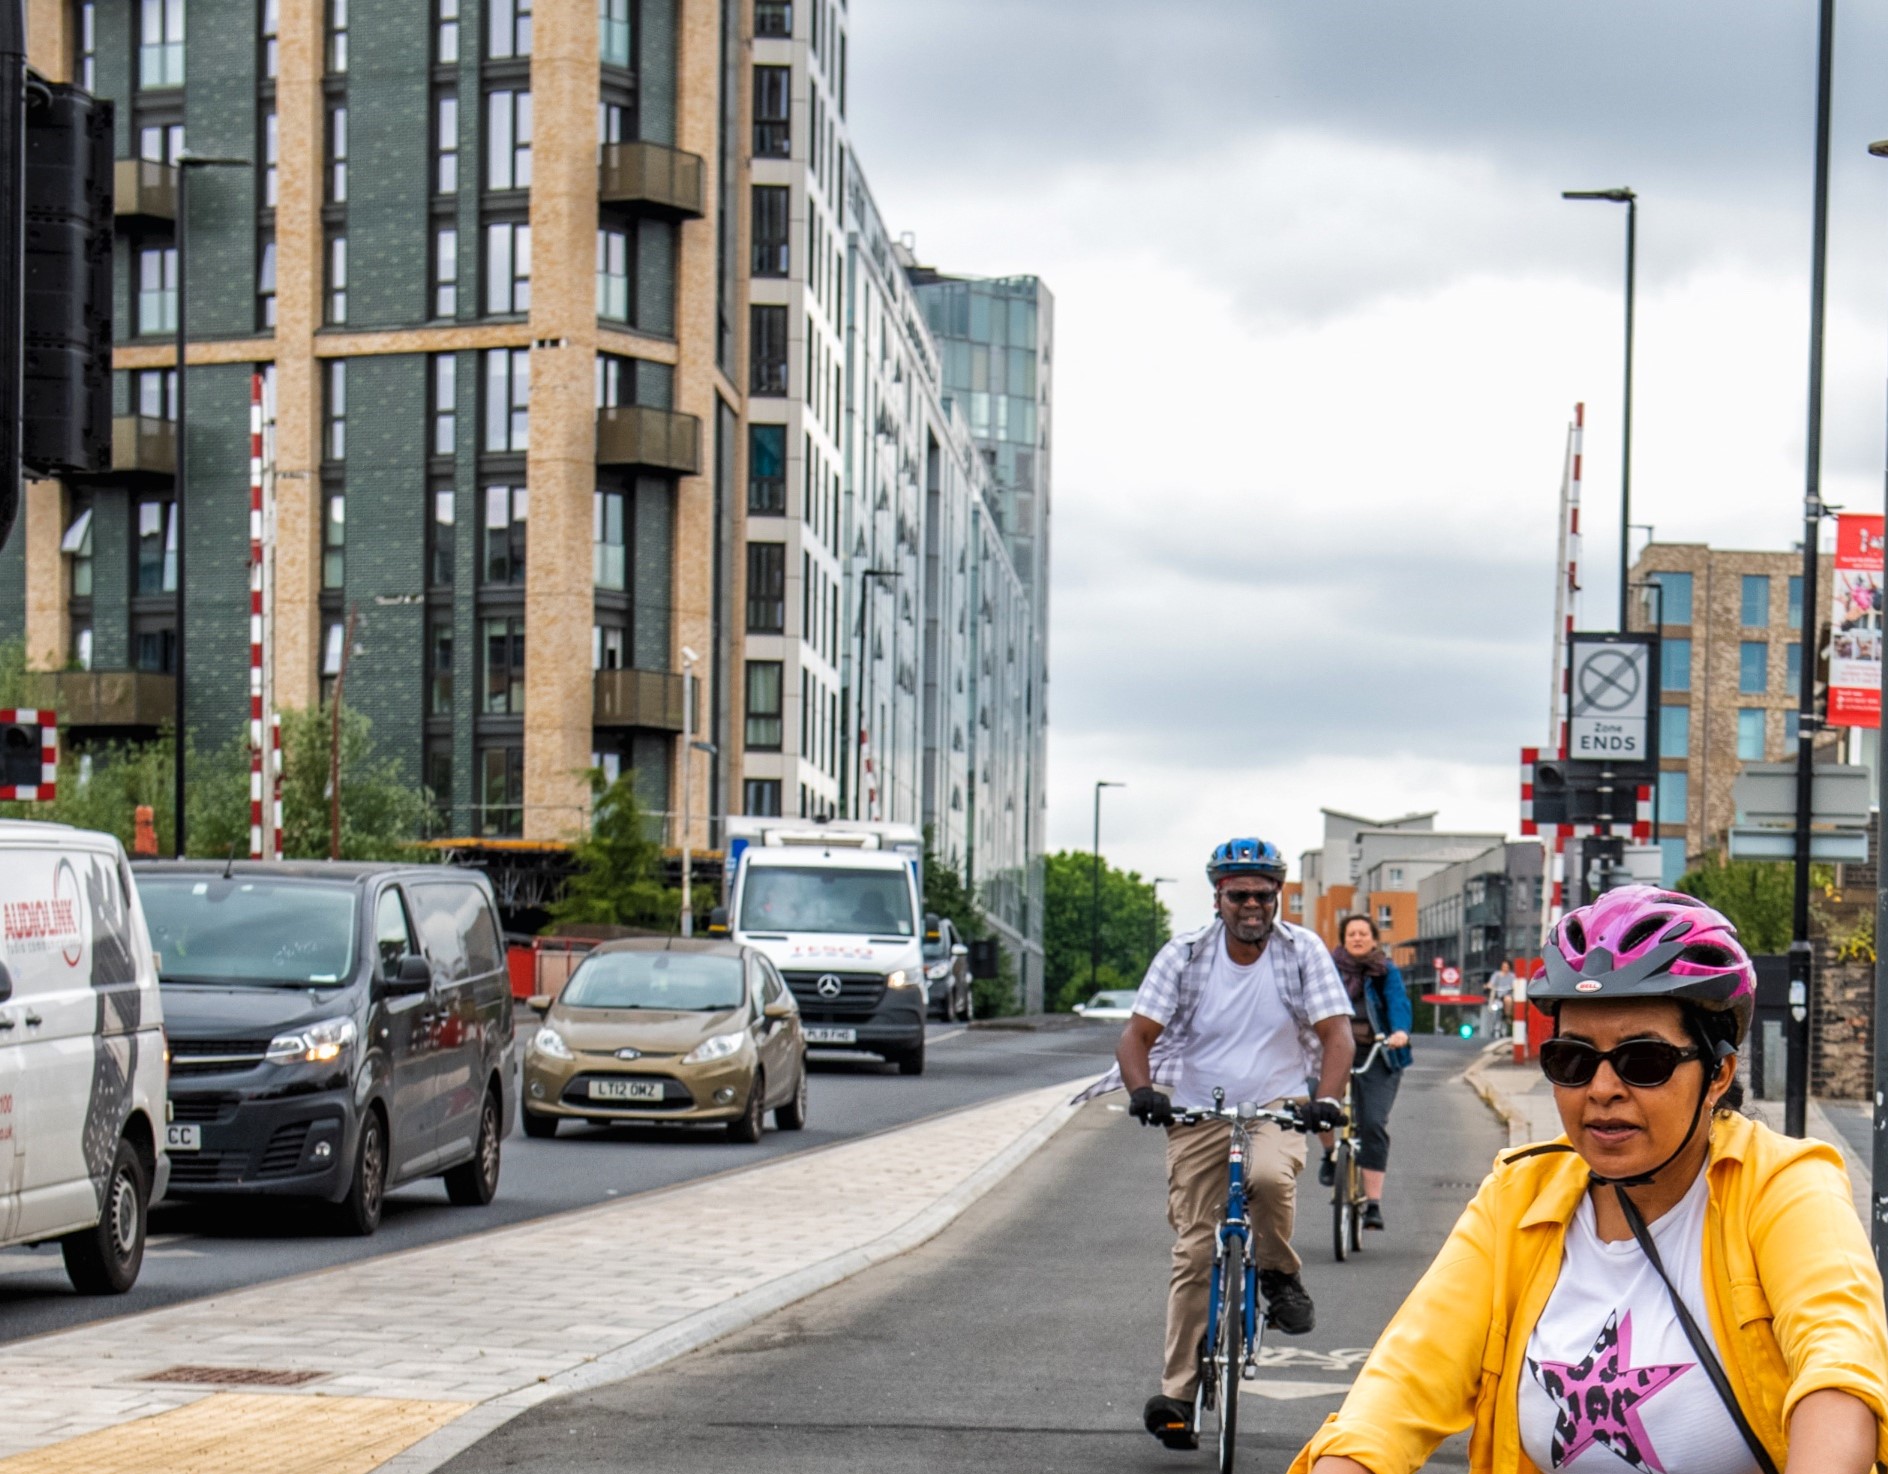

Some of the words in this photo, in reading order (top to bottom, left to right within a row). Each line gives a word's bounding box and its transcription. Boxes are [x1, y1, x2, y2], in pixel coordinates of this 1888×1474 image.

[1595, 722, 1622, 733] Zone
[1581, 736, 1635, 750] ENDS
[4, 899, 77, 940] AUDIOLINK
[167, 1127, 192, 1145] CC
